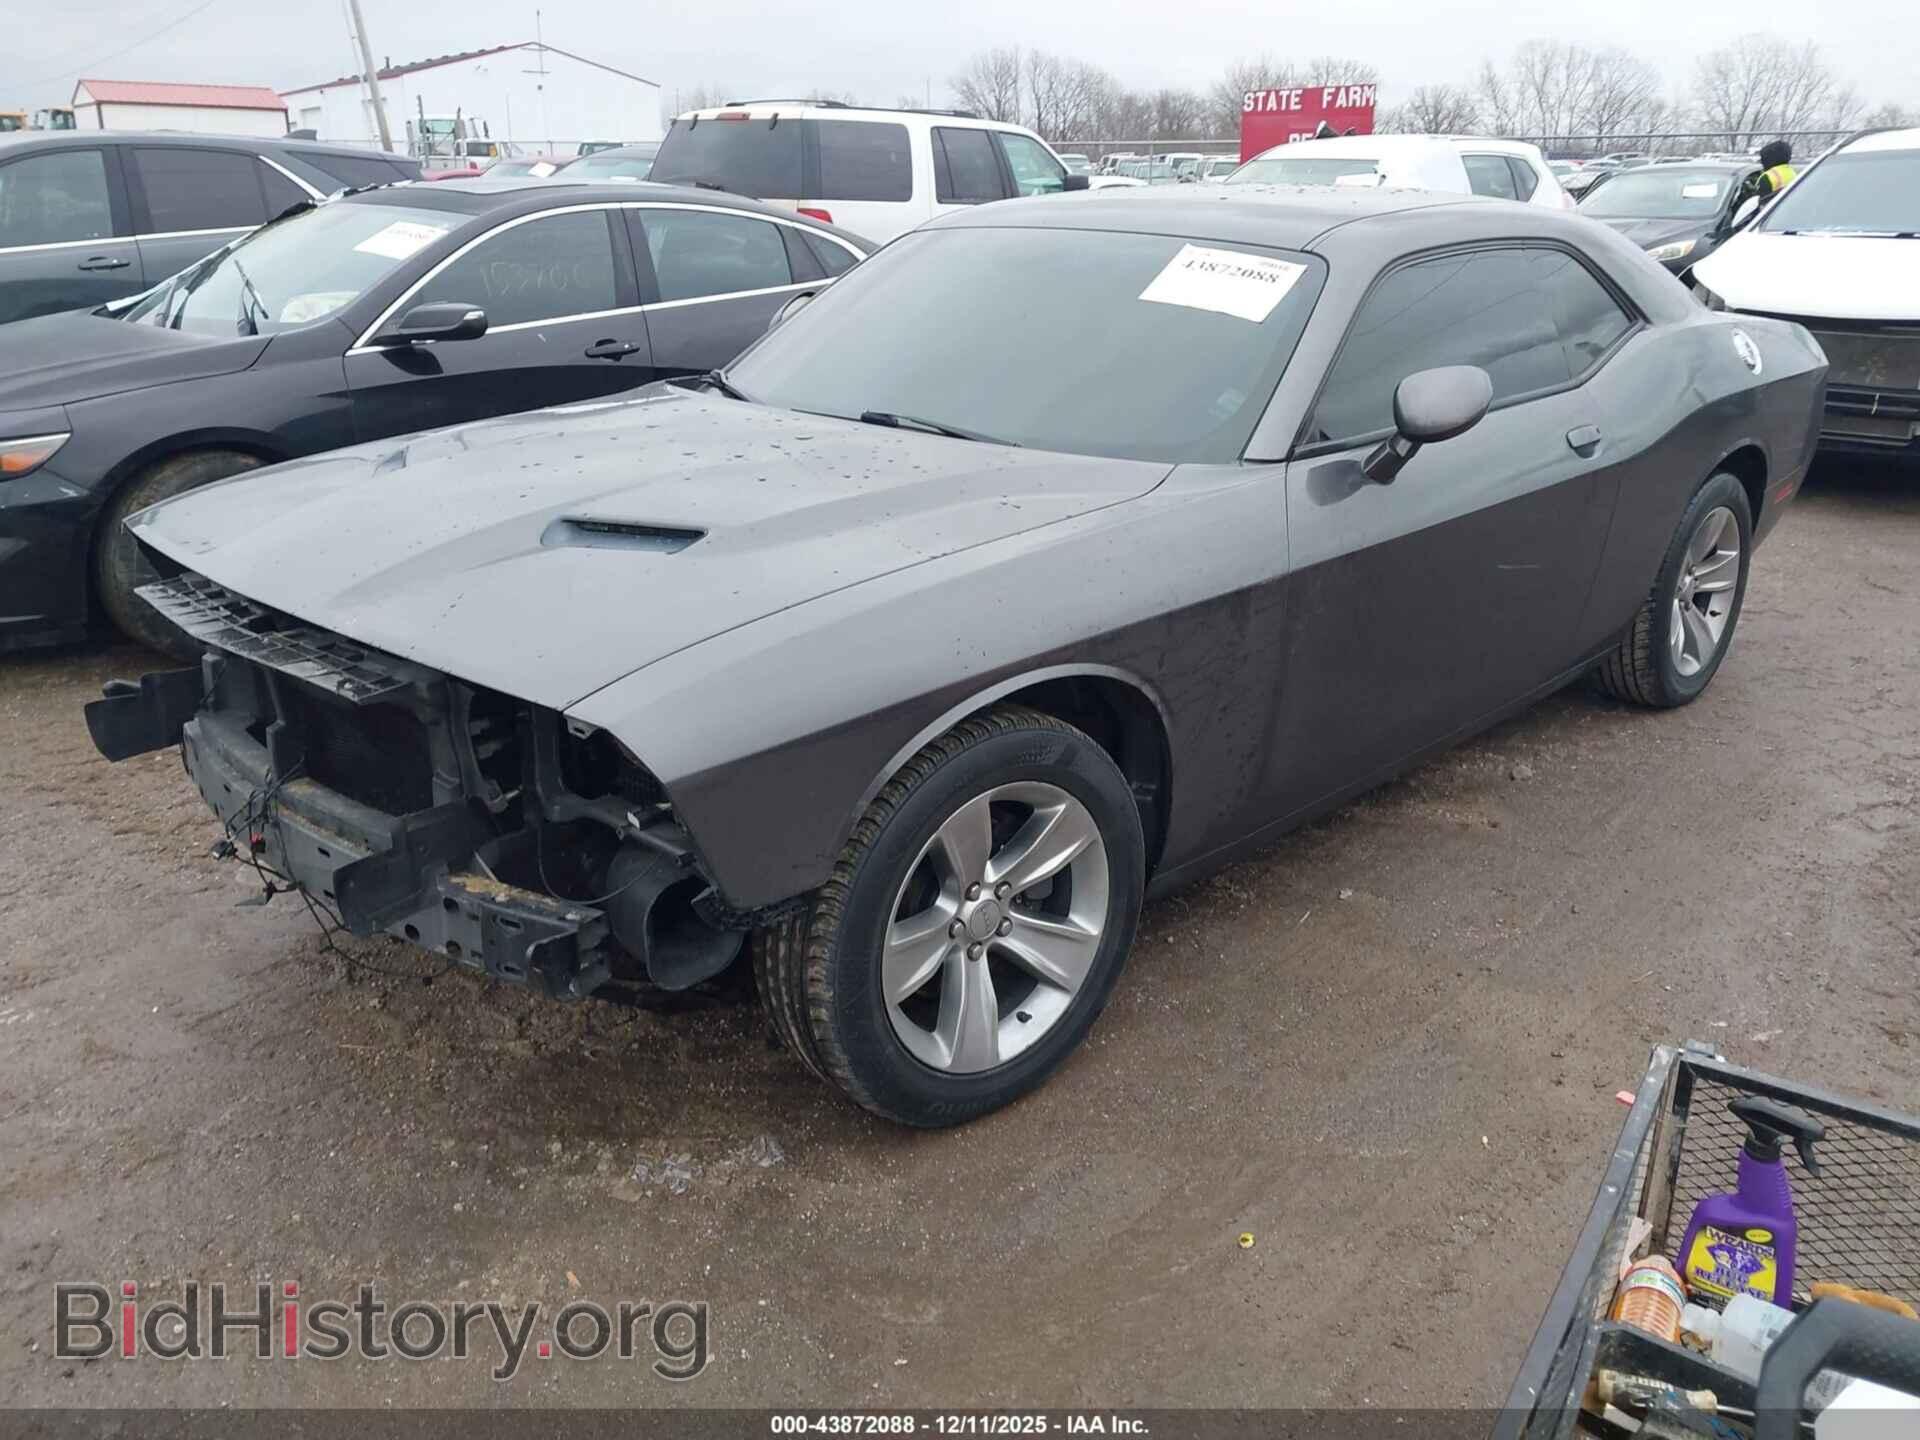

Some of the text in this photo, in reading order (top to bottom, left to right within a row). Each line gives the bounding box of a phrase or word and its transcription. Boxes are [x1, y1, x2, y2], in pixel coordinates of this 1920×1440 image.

[1243, 85, 1377, 112] STATE FARM
[1182, 260, 1280, 284] 43872088
[1706, 1226, 1775, 1258] WIZARDS
